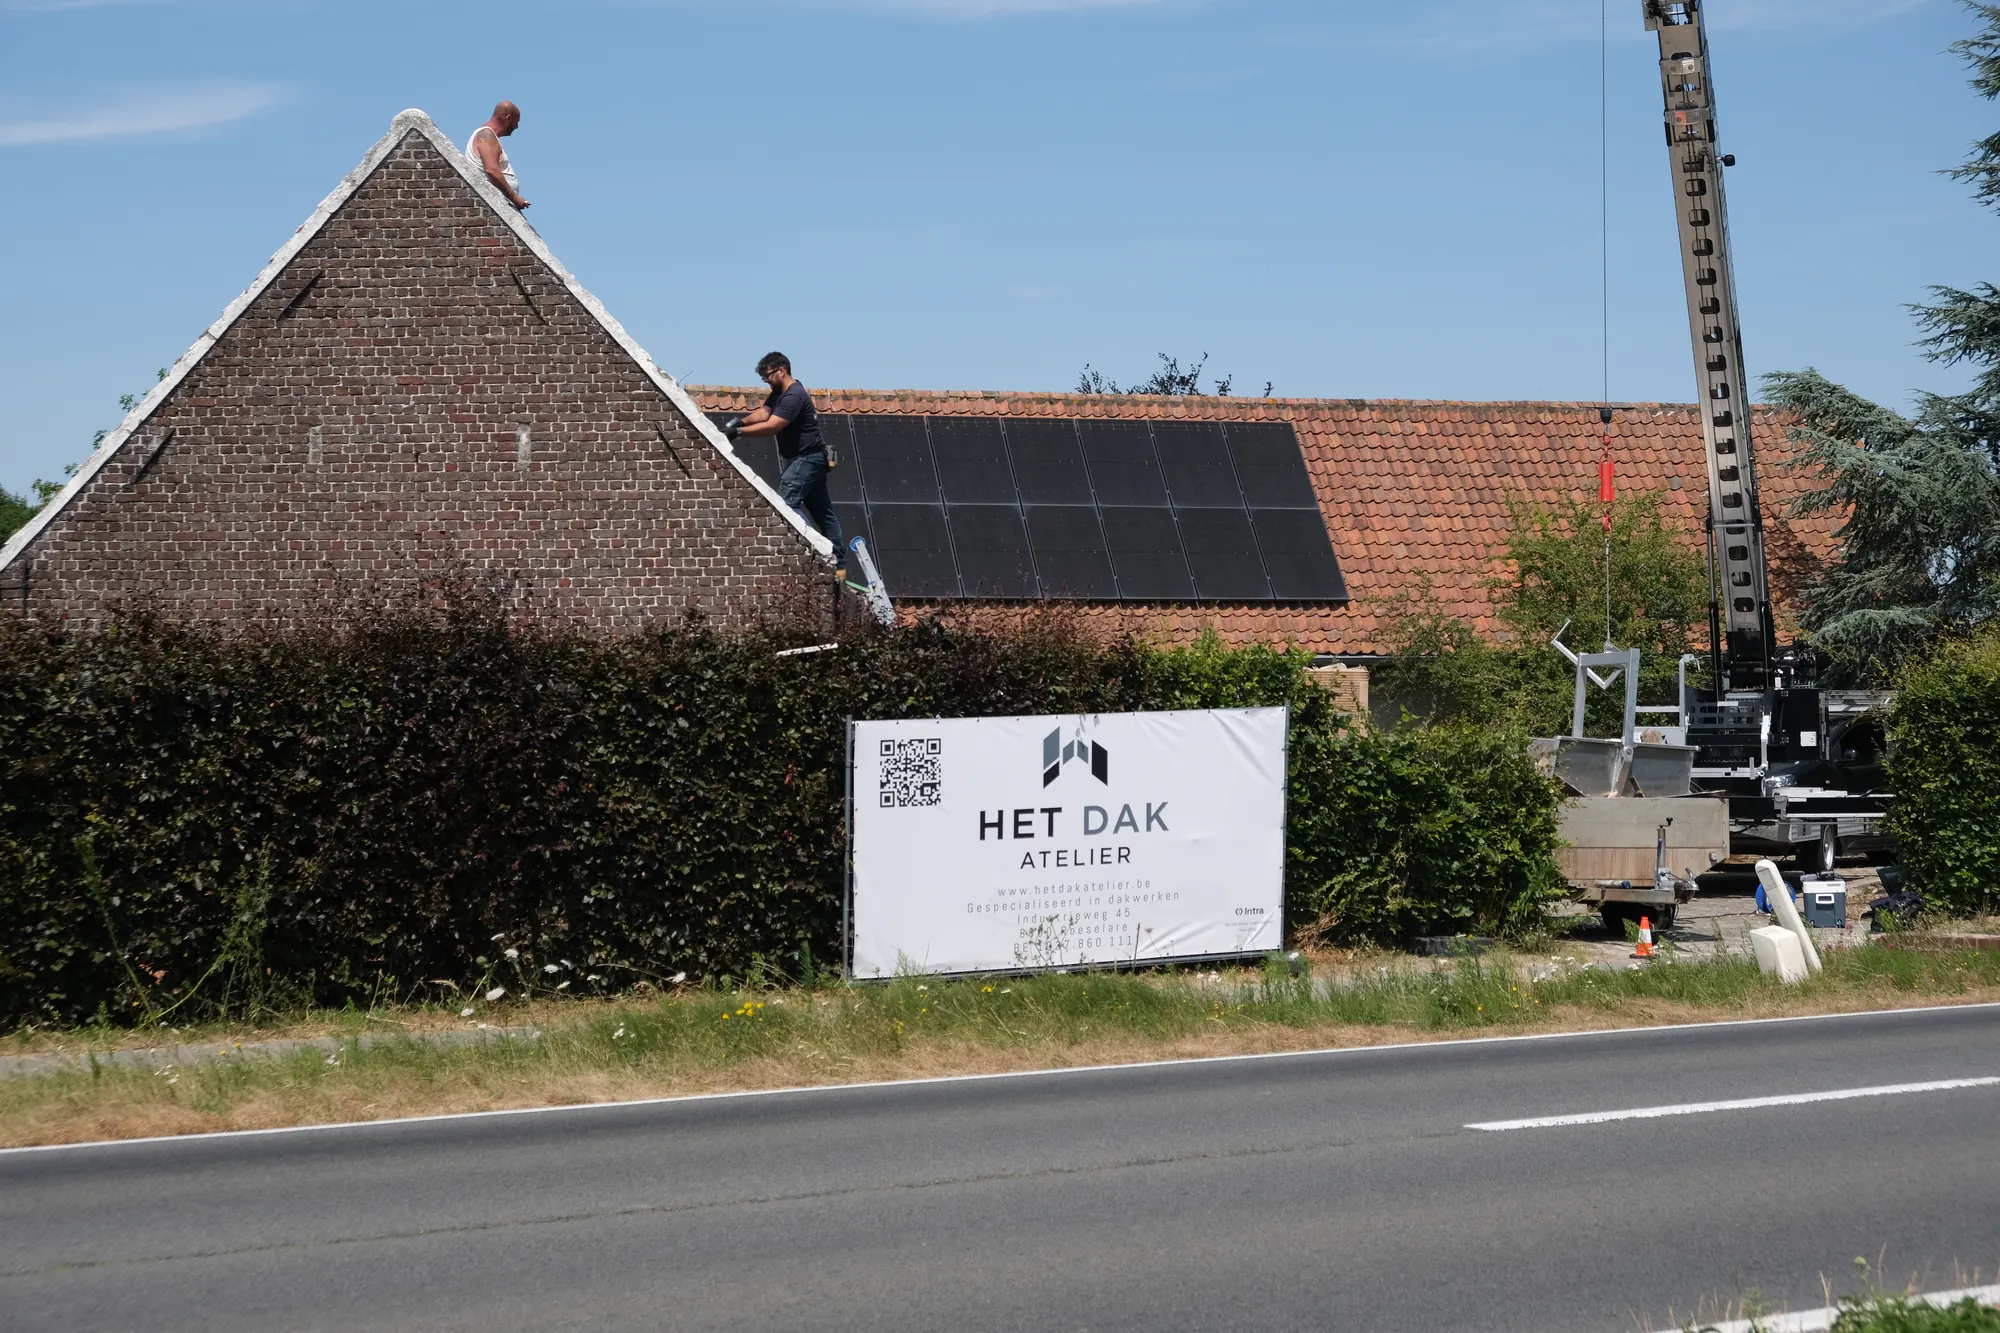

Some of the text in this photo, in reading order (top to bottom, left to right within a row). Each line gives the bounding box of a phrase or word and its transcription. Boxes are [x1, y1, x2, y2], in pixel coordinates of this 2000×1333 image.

[979, 801, 1170, 841] HET DAK
[1020, 846, 1131, 869] ATELIER
[997, 878, 1151, 897] www.hetdakatelier.be
[967, 890, 1180, 914] Gespecialiseerd in dakwerken
[1115, 907, 1131, 918] 45
[1244, 907, 1264, 916] Intra
[1060, 923, 1128, 936] Roeselare
[1014, 942, 1029, 953] BE
